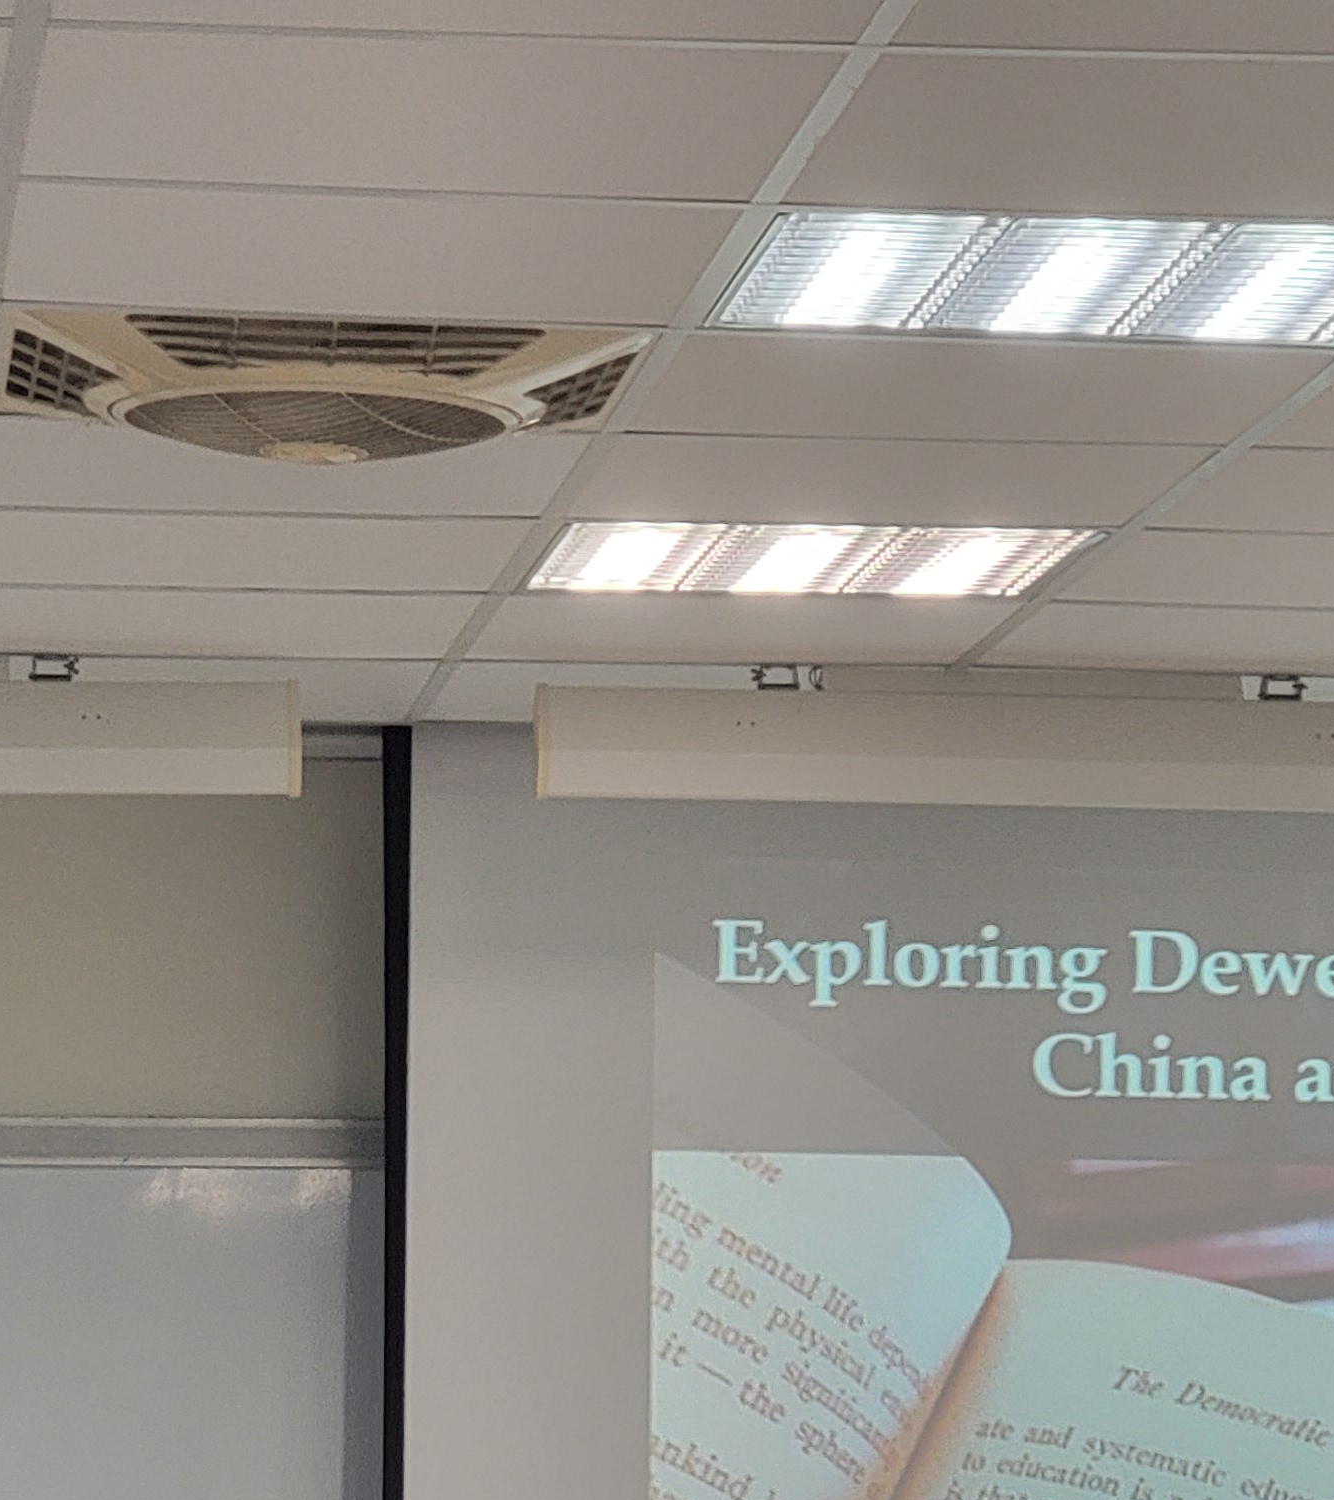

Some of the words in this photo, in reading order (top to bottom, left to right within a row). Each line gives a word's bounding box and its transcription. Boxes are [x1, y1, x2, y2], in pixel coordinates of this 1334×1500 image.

[711, 917, 1109, 1014] Exploring
[1031, 1032, 1271, 1101] China
[717, 1226, 822, 1302] mental
[823, 1284, 866, 1333] life
[690, 1306, 769, 1365] more
[707, 1265, 757, 1309] the
[764, 1304, 878, 1390] physical
[738, 1378, 788, 1424] the
[1112, 1366, 1165, 1398] The
[1173, 1379, 1333, 1452] Democratic
[962, 1451, 988, 1474] to
[995, 1453, 1121, 1498] education
[1023, 1424, 1075, 1450] and
[1082, 1435, 1229, 1487] systematic
